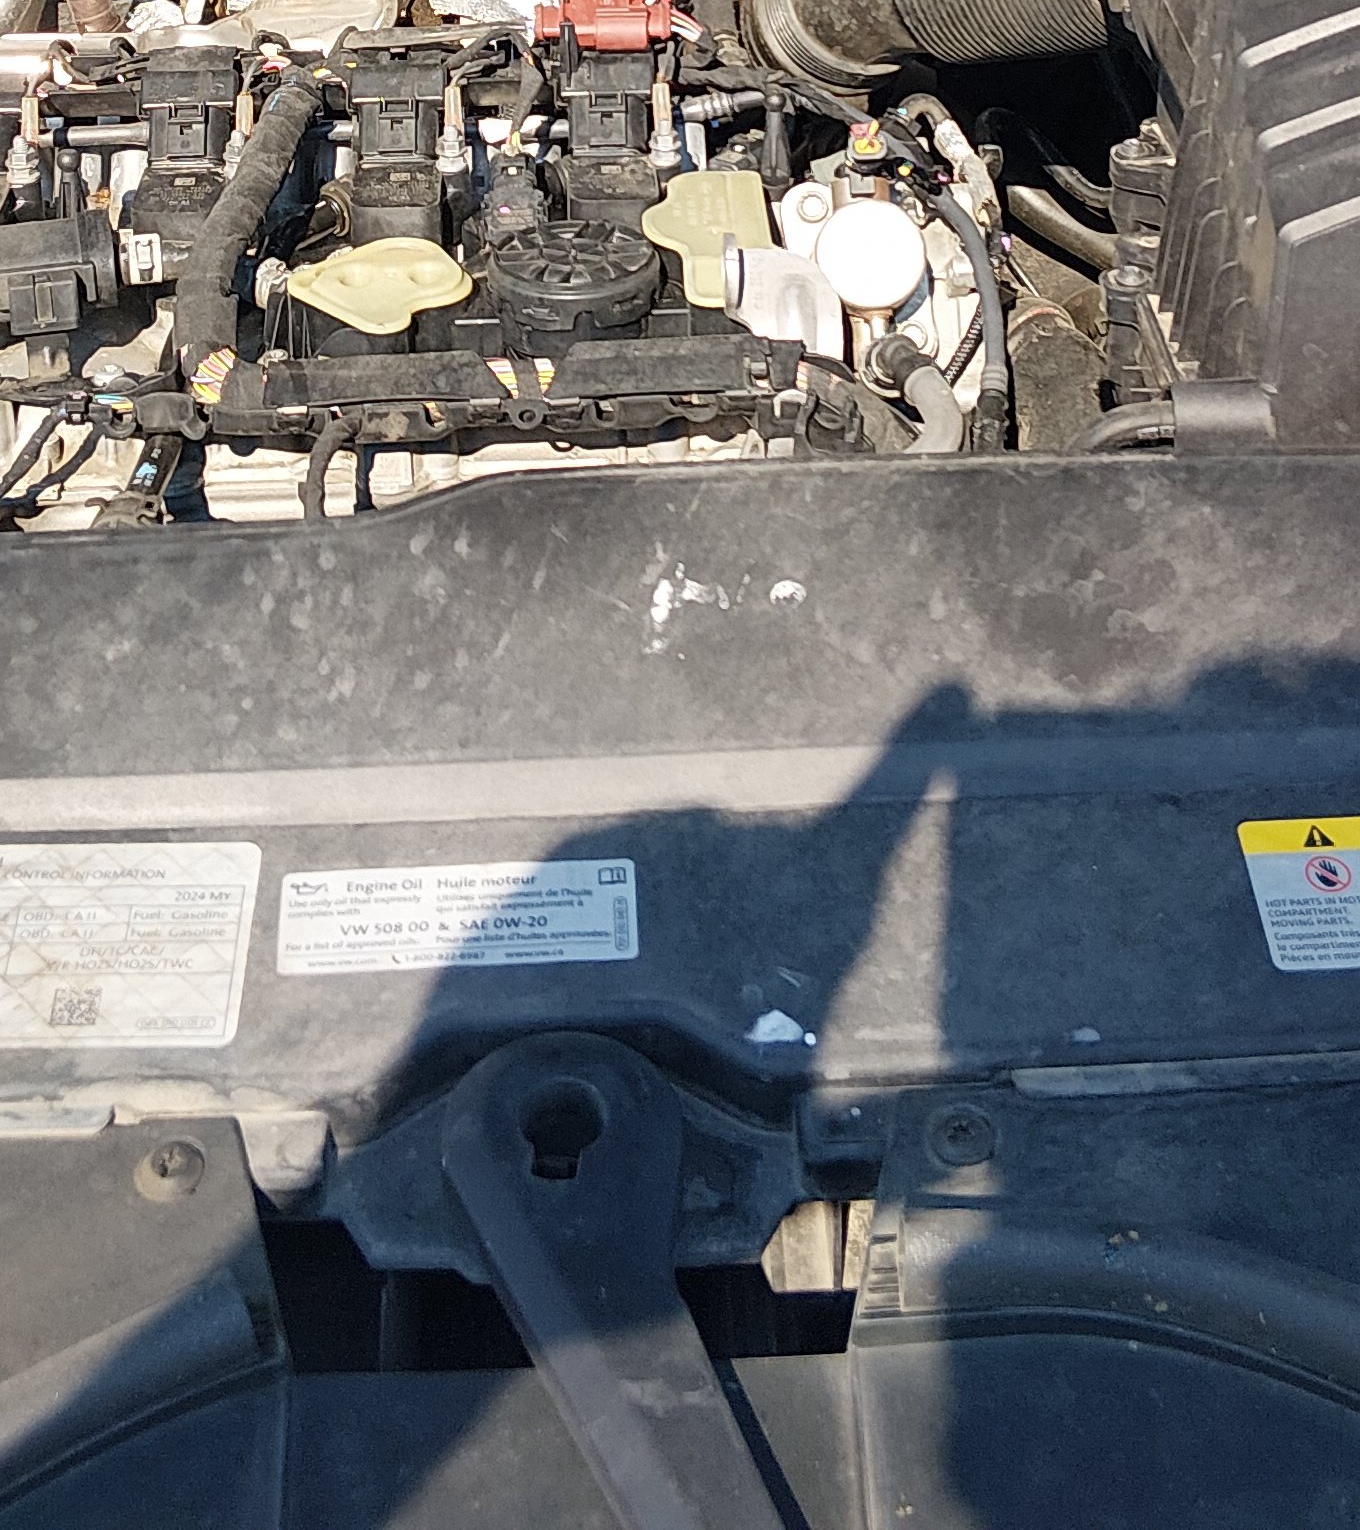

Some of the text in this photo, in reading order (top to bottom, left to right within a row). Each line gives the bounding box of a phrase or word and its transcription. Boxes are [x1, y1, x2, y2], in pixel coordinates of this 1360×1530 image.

[3, 870, 66, 880] CONTROL
[71, 869, 166, 880] INFORMATION
[347, 878, 422, 895] Engine Oil
[437, 875, 537, 889] Huile moteur
[175, 890, 231, 901] 2024 MY
[1265, 898, 1287, 908] HOT
[1289, 896, 1322, 907] PARTS
[1325, 896, 1336, 905] IN
[171, 909, 229, 920] Gasoline
[340, 915, 548, 936] VW 508 00 & SAE 0W-20
[1271, 916, 1353, 928] MOVING PARTS.
[168, 926, 227, 938] Gasoline
[1274, 930, 1338, 942] Composants
[1277, 942, 1287, 951] le
[1317, 952, 1331, 961] en
